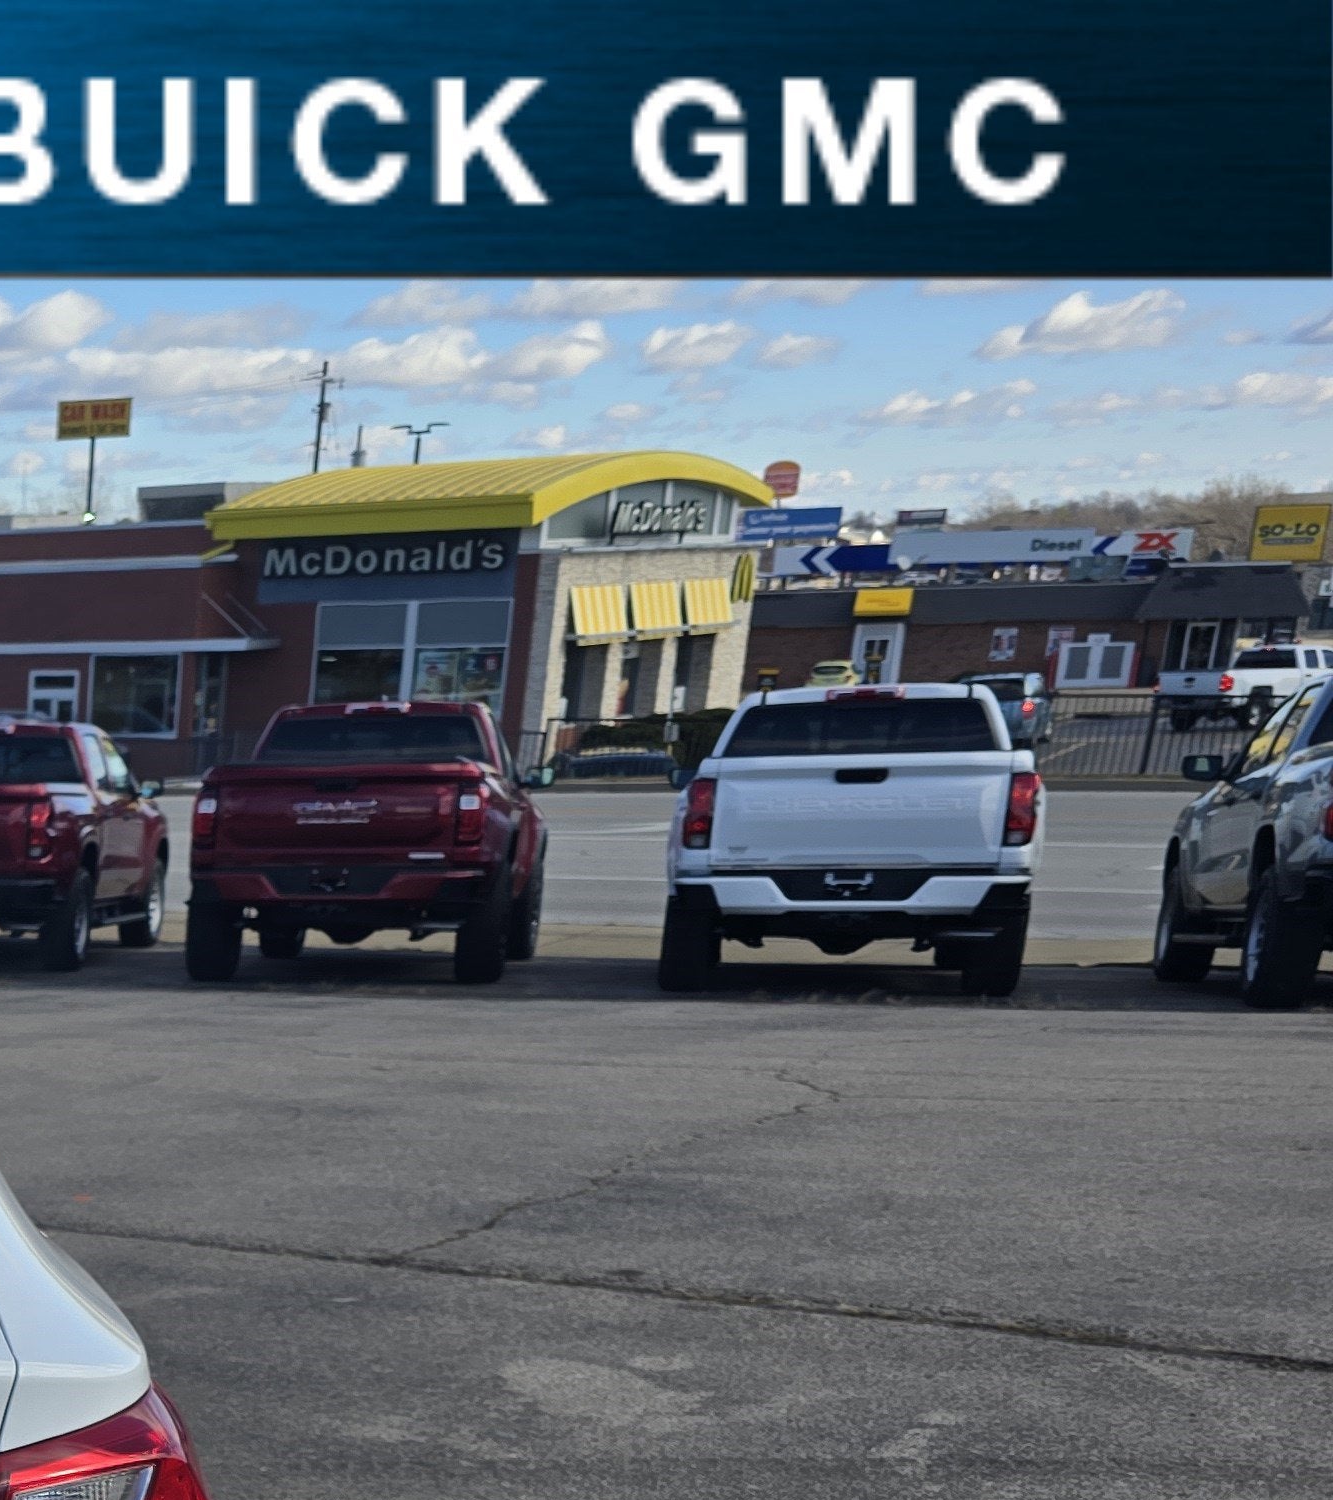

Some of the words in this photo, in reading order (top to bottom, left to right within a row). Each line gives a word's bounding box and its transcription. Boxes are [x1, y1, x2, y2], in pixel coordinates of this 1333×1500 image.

[611, 501, 707, 533] McDonald's
[262, 538, 505, 577] McDonald's
[1030, 538, 1083, 553] Diesel
